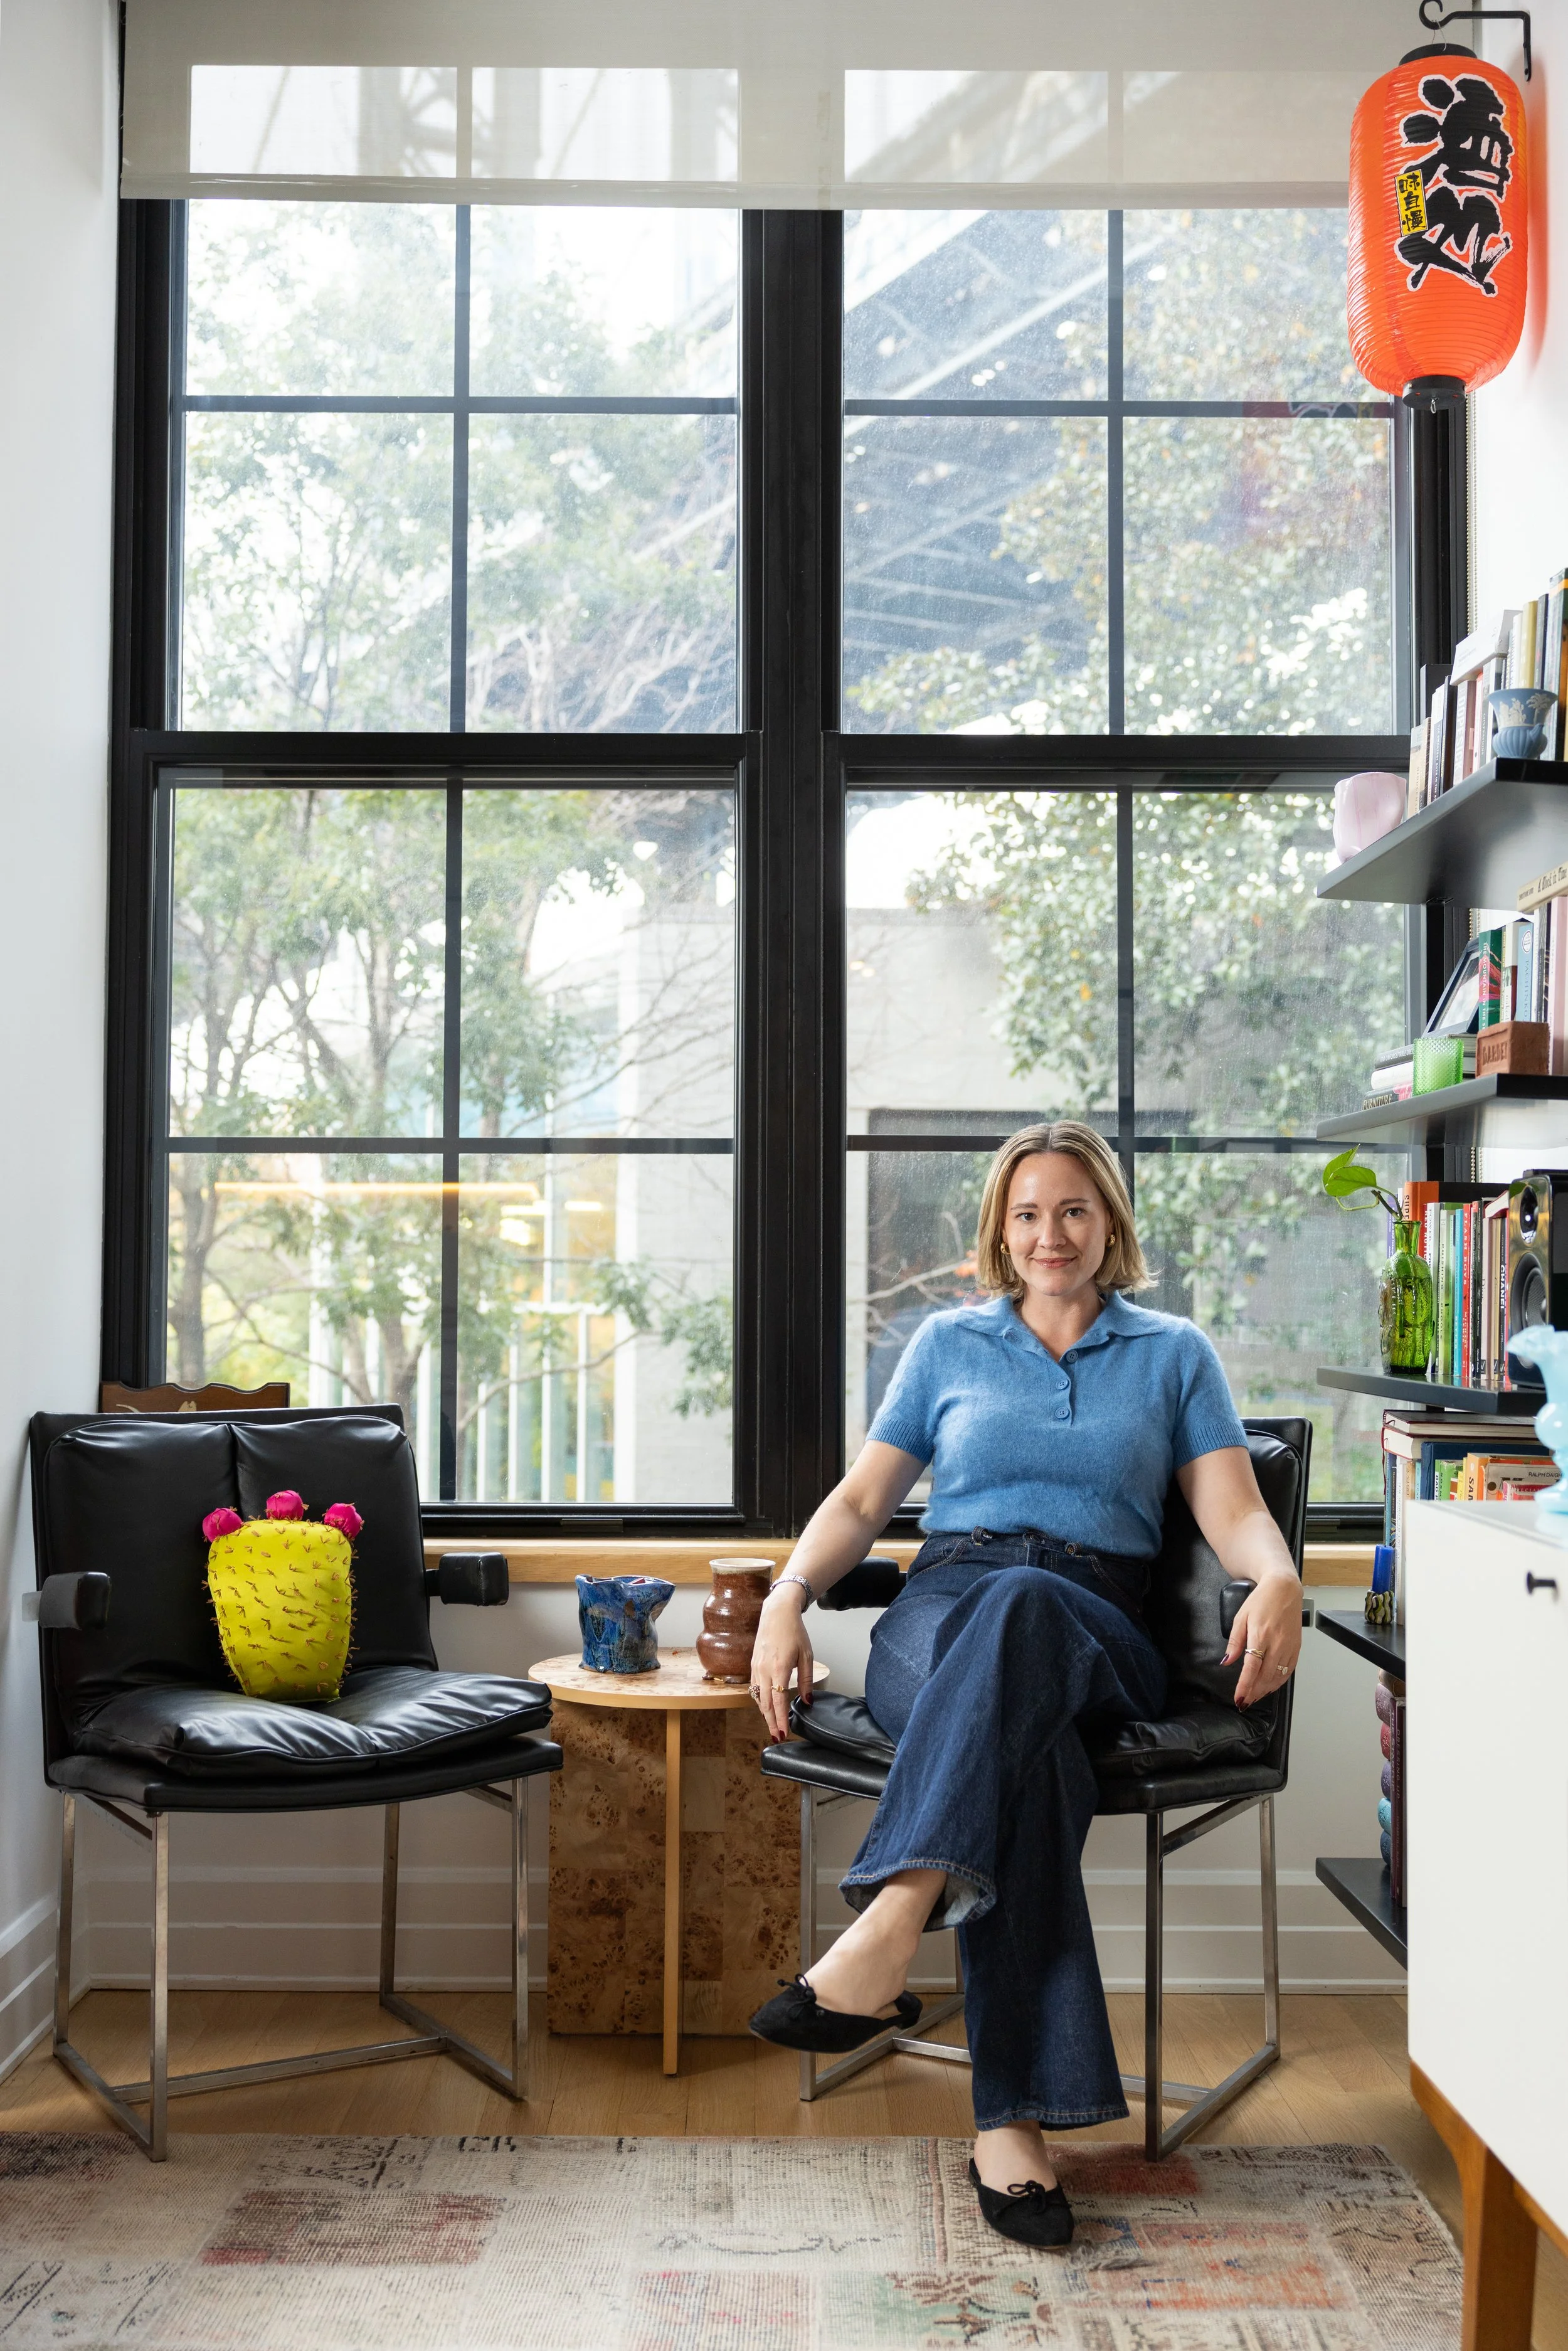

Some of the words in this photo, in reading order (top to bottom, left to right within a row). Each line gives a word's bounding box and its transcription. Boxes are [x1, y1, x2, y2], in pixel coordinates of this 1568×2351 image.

[1398, 172, 1426, 231] 味自慢
[1456, 696, 1466, 771] DOPESICK
[1553, 870, 1557, 884] in
[1558, 866, 1567, 881] Time
[1385, 1051, 1406, 1061] UNFORGETTABLE
[1362, 1095, 1392, 1110] FURNITURE
